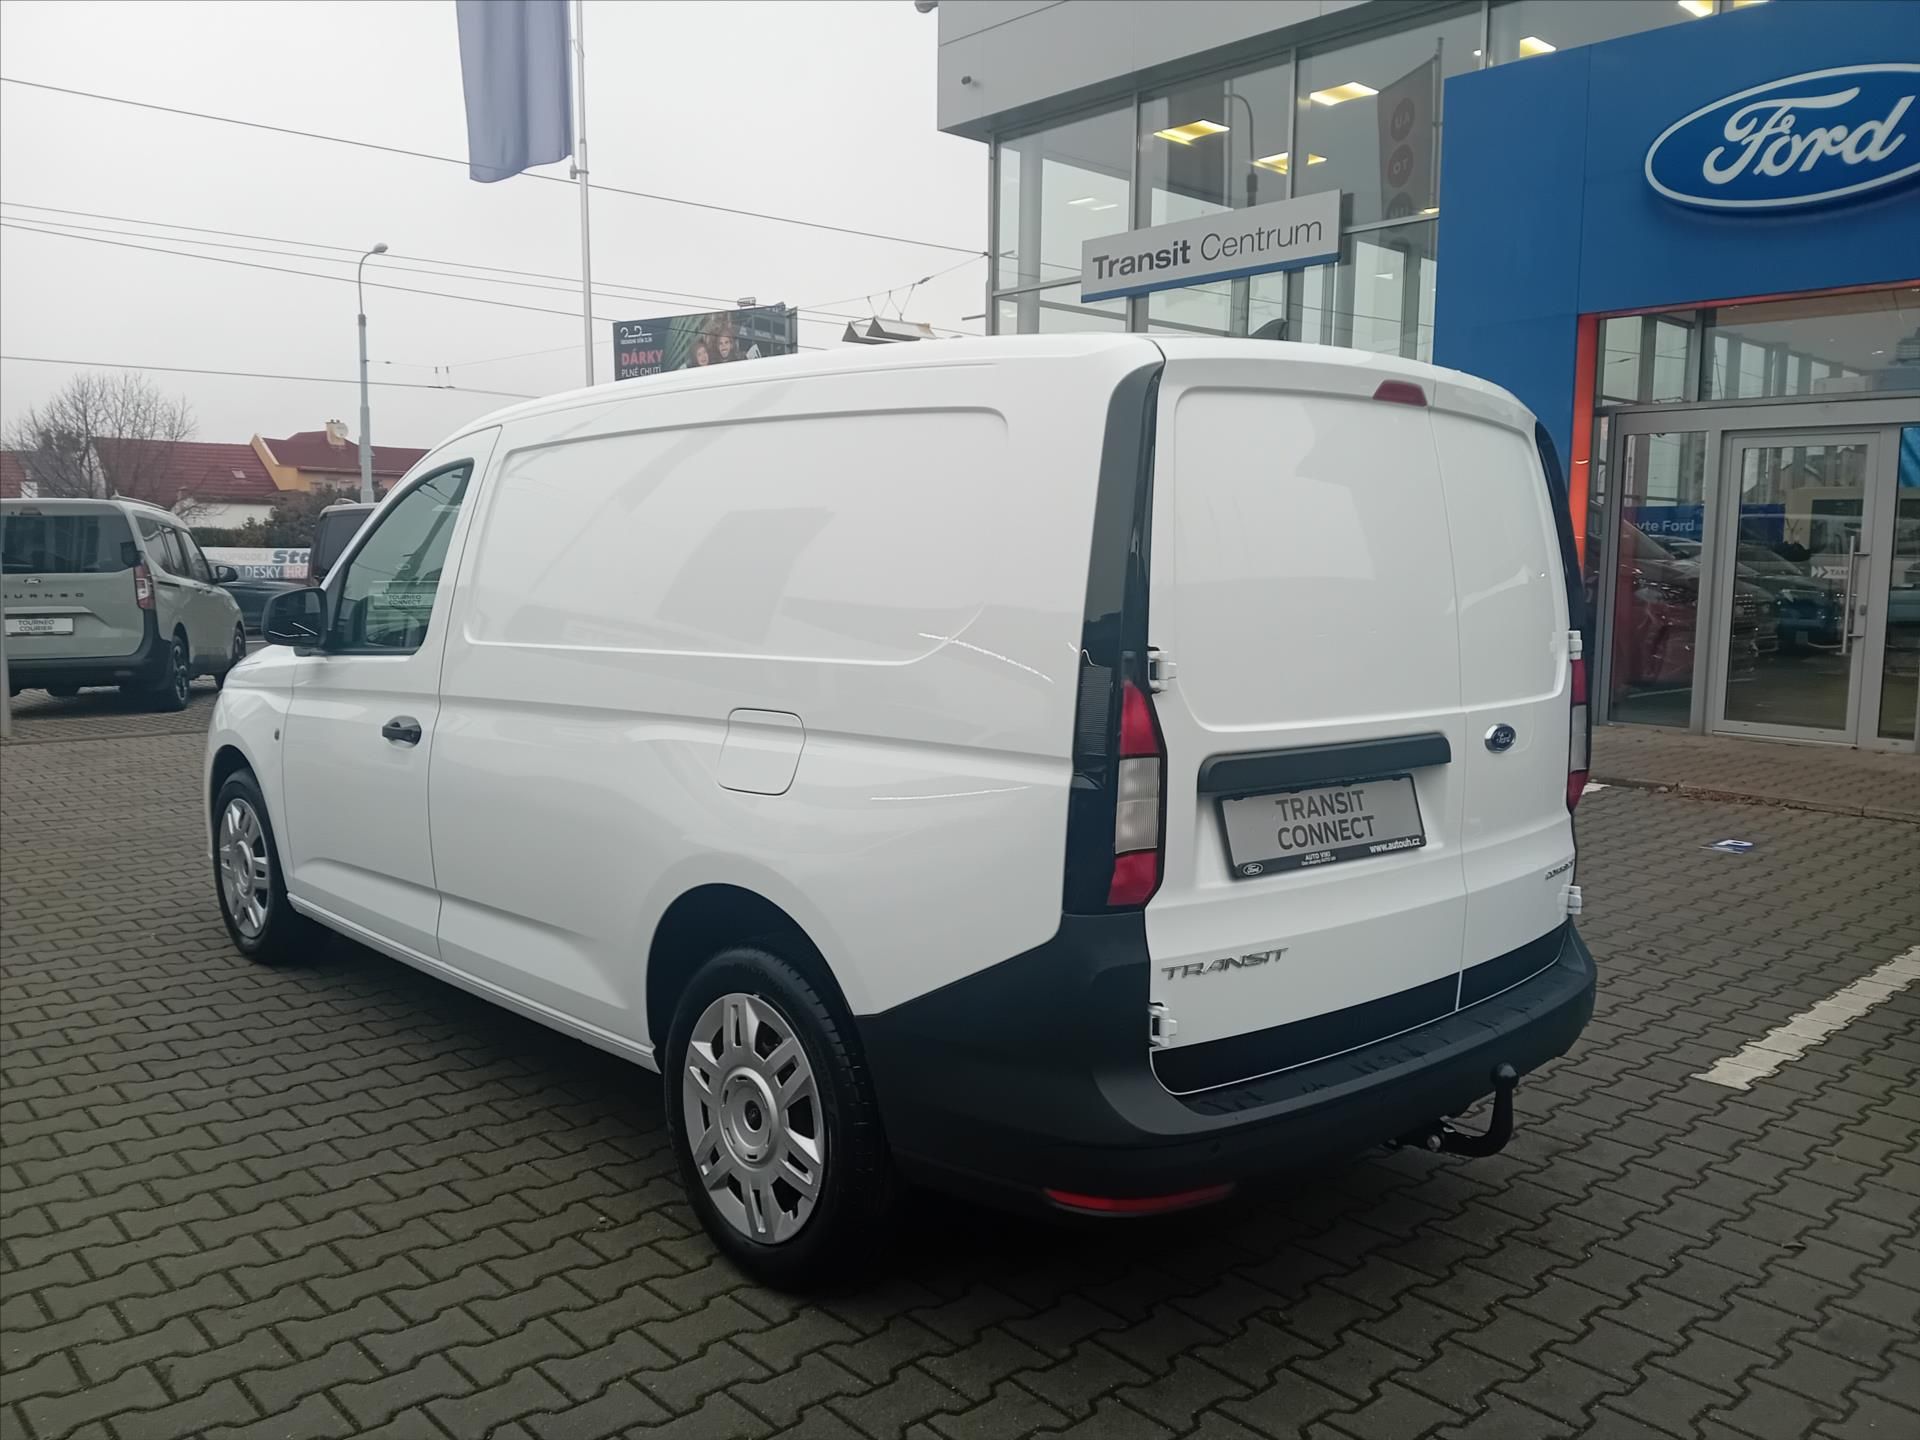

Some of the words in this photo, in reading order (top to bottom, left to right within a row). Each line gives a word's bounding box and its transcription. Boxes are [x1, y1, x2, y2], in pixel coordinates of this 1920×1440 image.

[1703, 86, 1915, 185] Ford
[1092, 239, 1191, 280] Transit
[1200, 220, 1322, 261] Centrum
[621, 348, 663, 366] DÁRKY
[1662, 519, 1695, 532] Ford
[245, 566, 281, 578] DESKY
[1275, 790, 1365, 822] TRANSIT
[1277, 815, 1375, 850] CONNECT
[1161, 947, 1289, 980] TRANSIT
